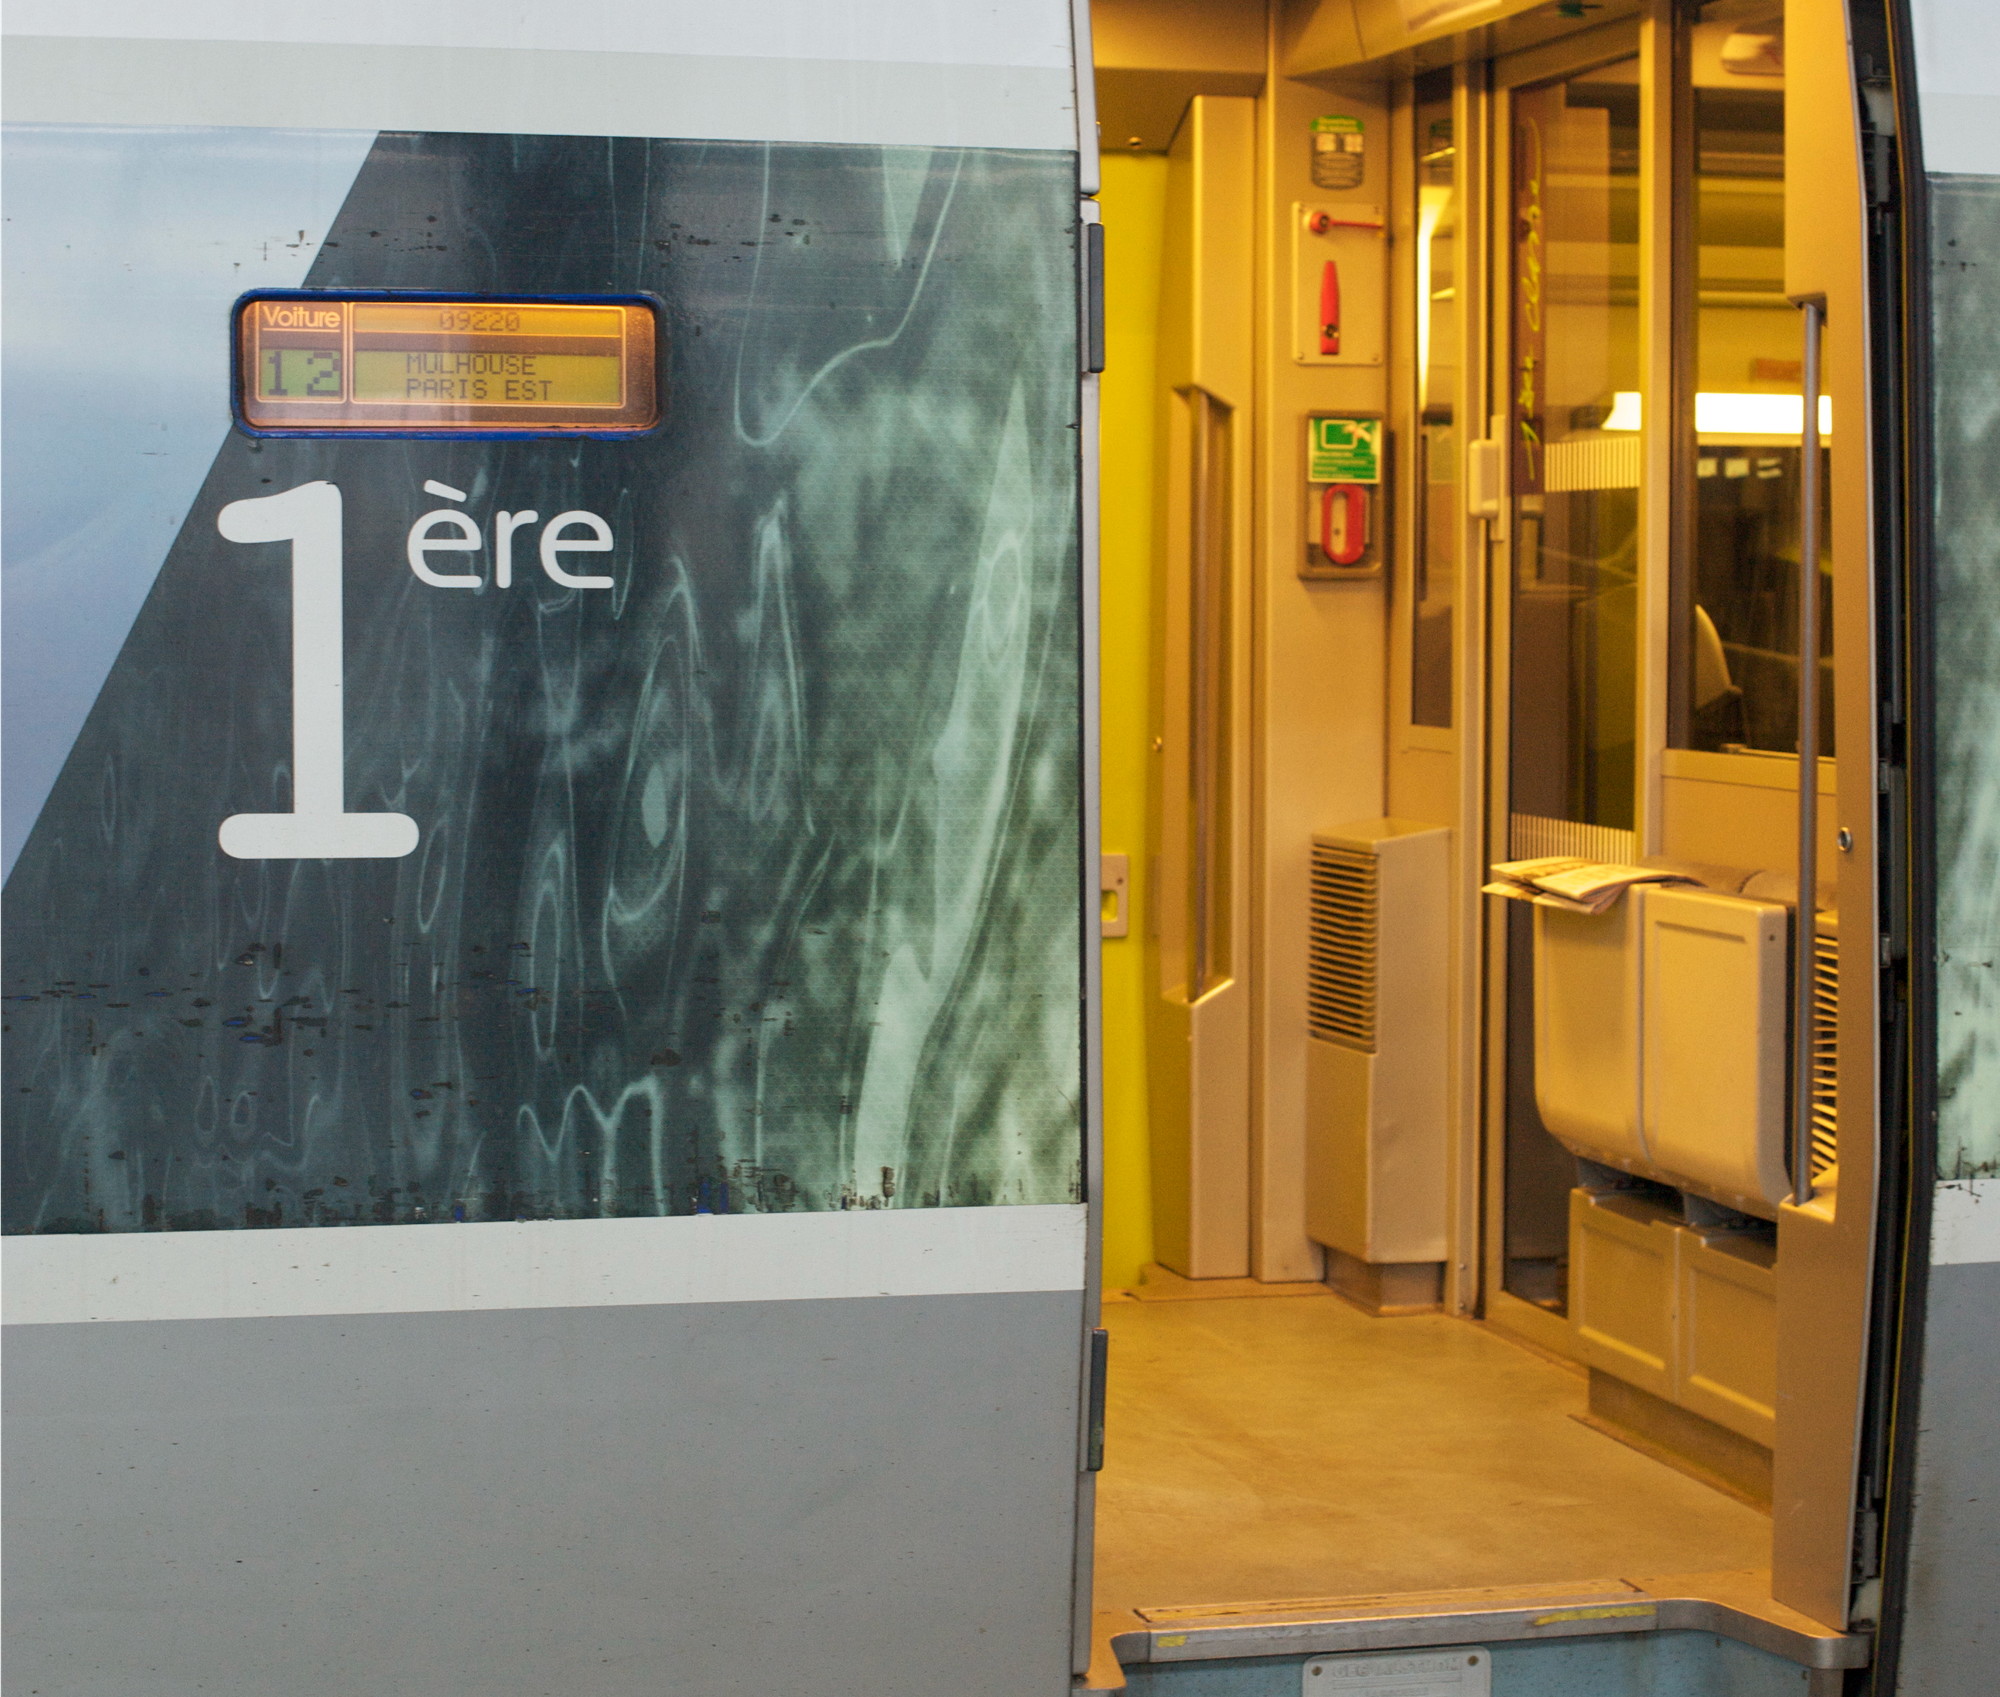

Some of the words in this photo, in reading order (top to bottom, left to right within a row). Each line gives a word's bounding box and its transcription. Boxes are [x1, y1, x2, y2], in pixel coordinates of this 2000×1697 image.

[263, 306, 341, 328] Voiture
[439, 311, 520, 332] 09220
[268, 351, 342, 396] 12
[407, 353, 537, 375] MULHOUSE
[407, 378, 487, 400] PARIS
[505, 380, 552, 401] EST
